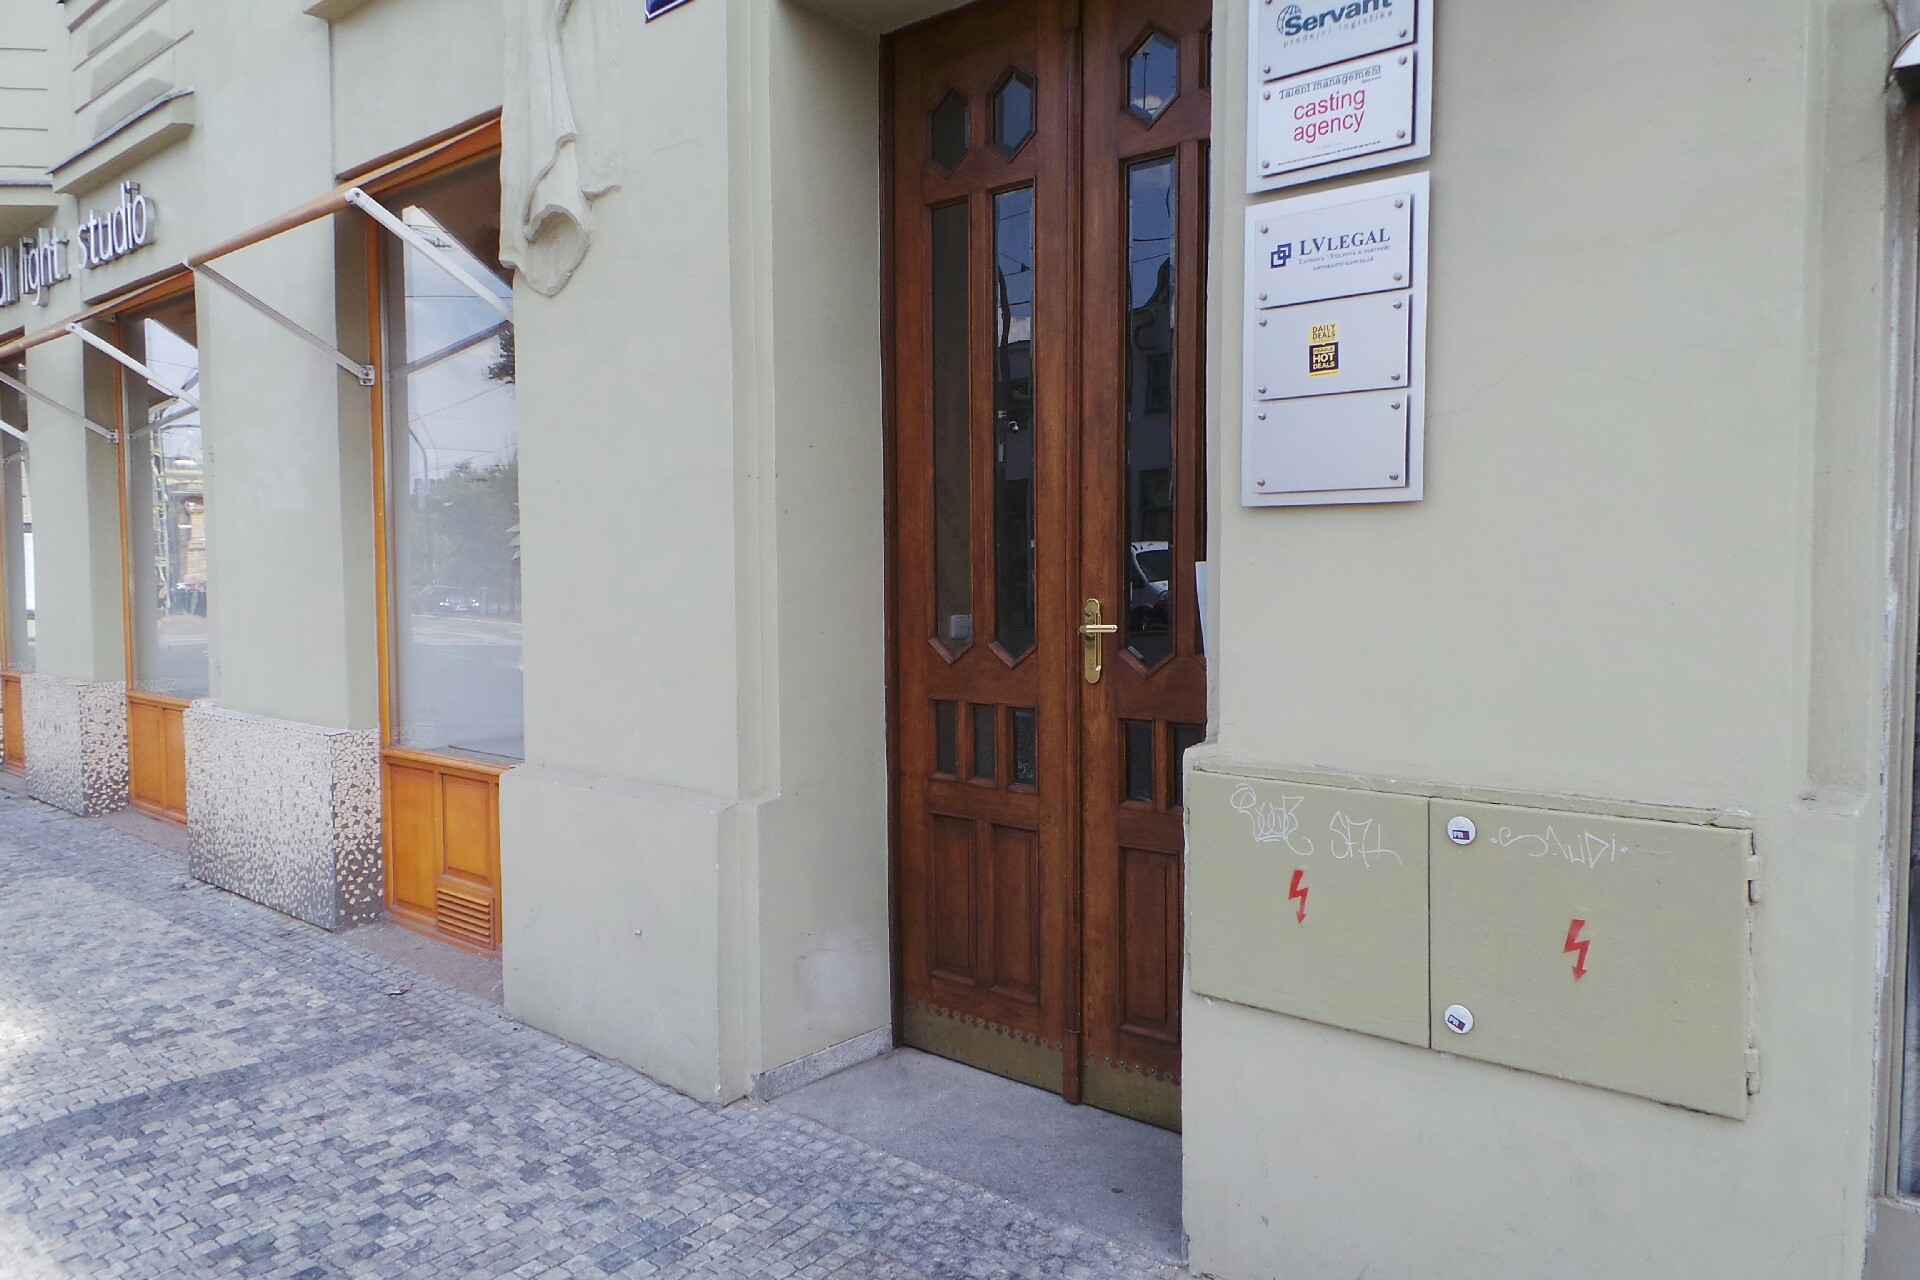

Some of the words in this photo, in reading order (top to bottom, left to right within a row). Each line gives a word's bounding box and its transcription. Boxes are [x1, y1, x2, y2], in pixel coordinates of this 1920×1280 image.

[1339, 10, 1392, 30] logistika
[1279, 83, 1311, 100] Talent
[1313, 65, 1381, 91] management
[1294, 89, 1365, 120] casting
[1293, 111, 1365, 143] agency
[20, 227, 62, 306] light
[78, 180, 147, 269] studio
[1312, 323, 1336, 334] DAILY
[1312, 330, 1336, 340] DEALS
[1312, 352, 1336, 364] HOT
[1312, 361, 1336, 370] DEALS
